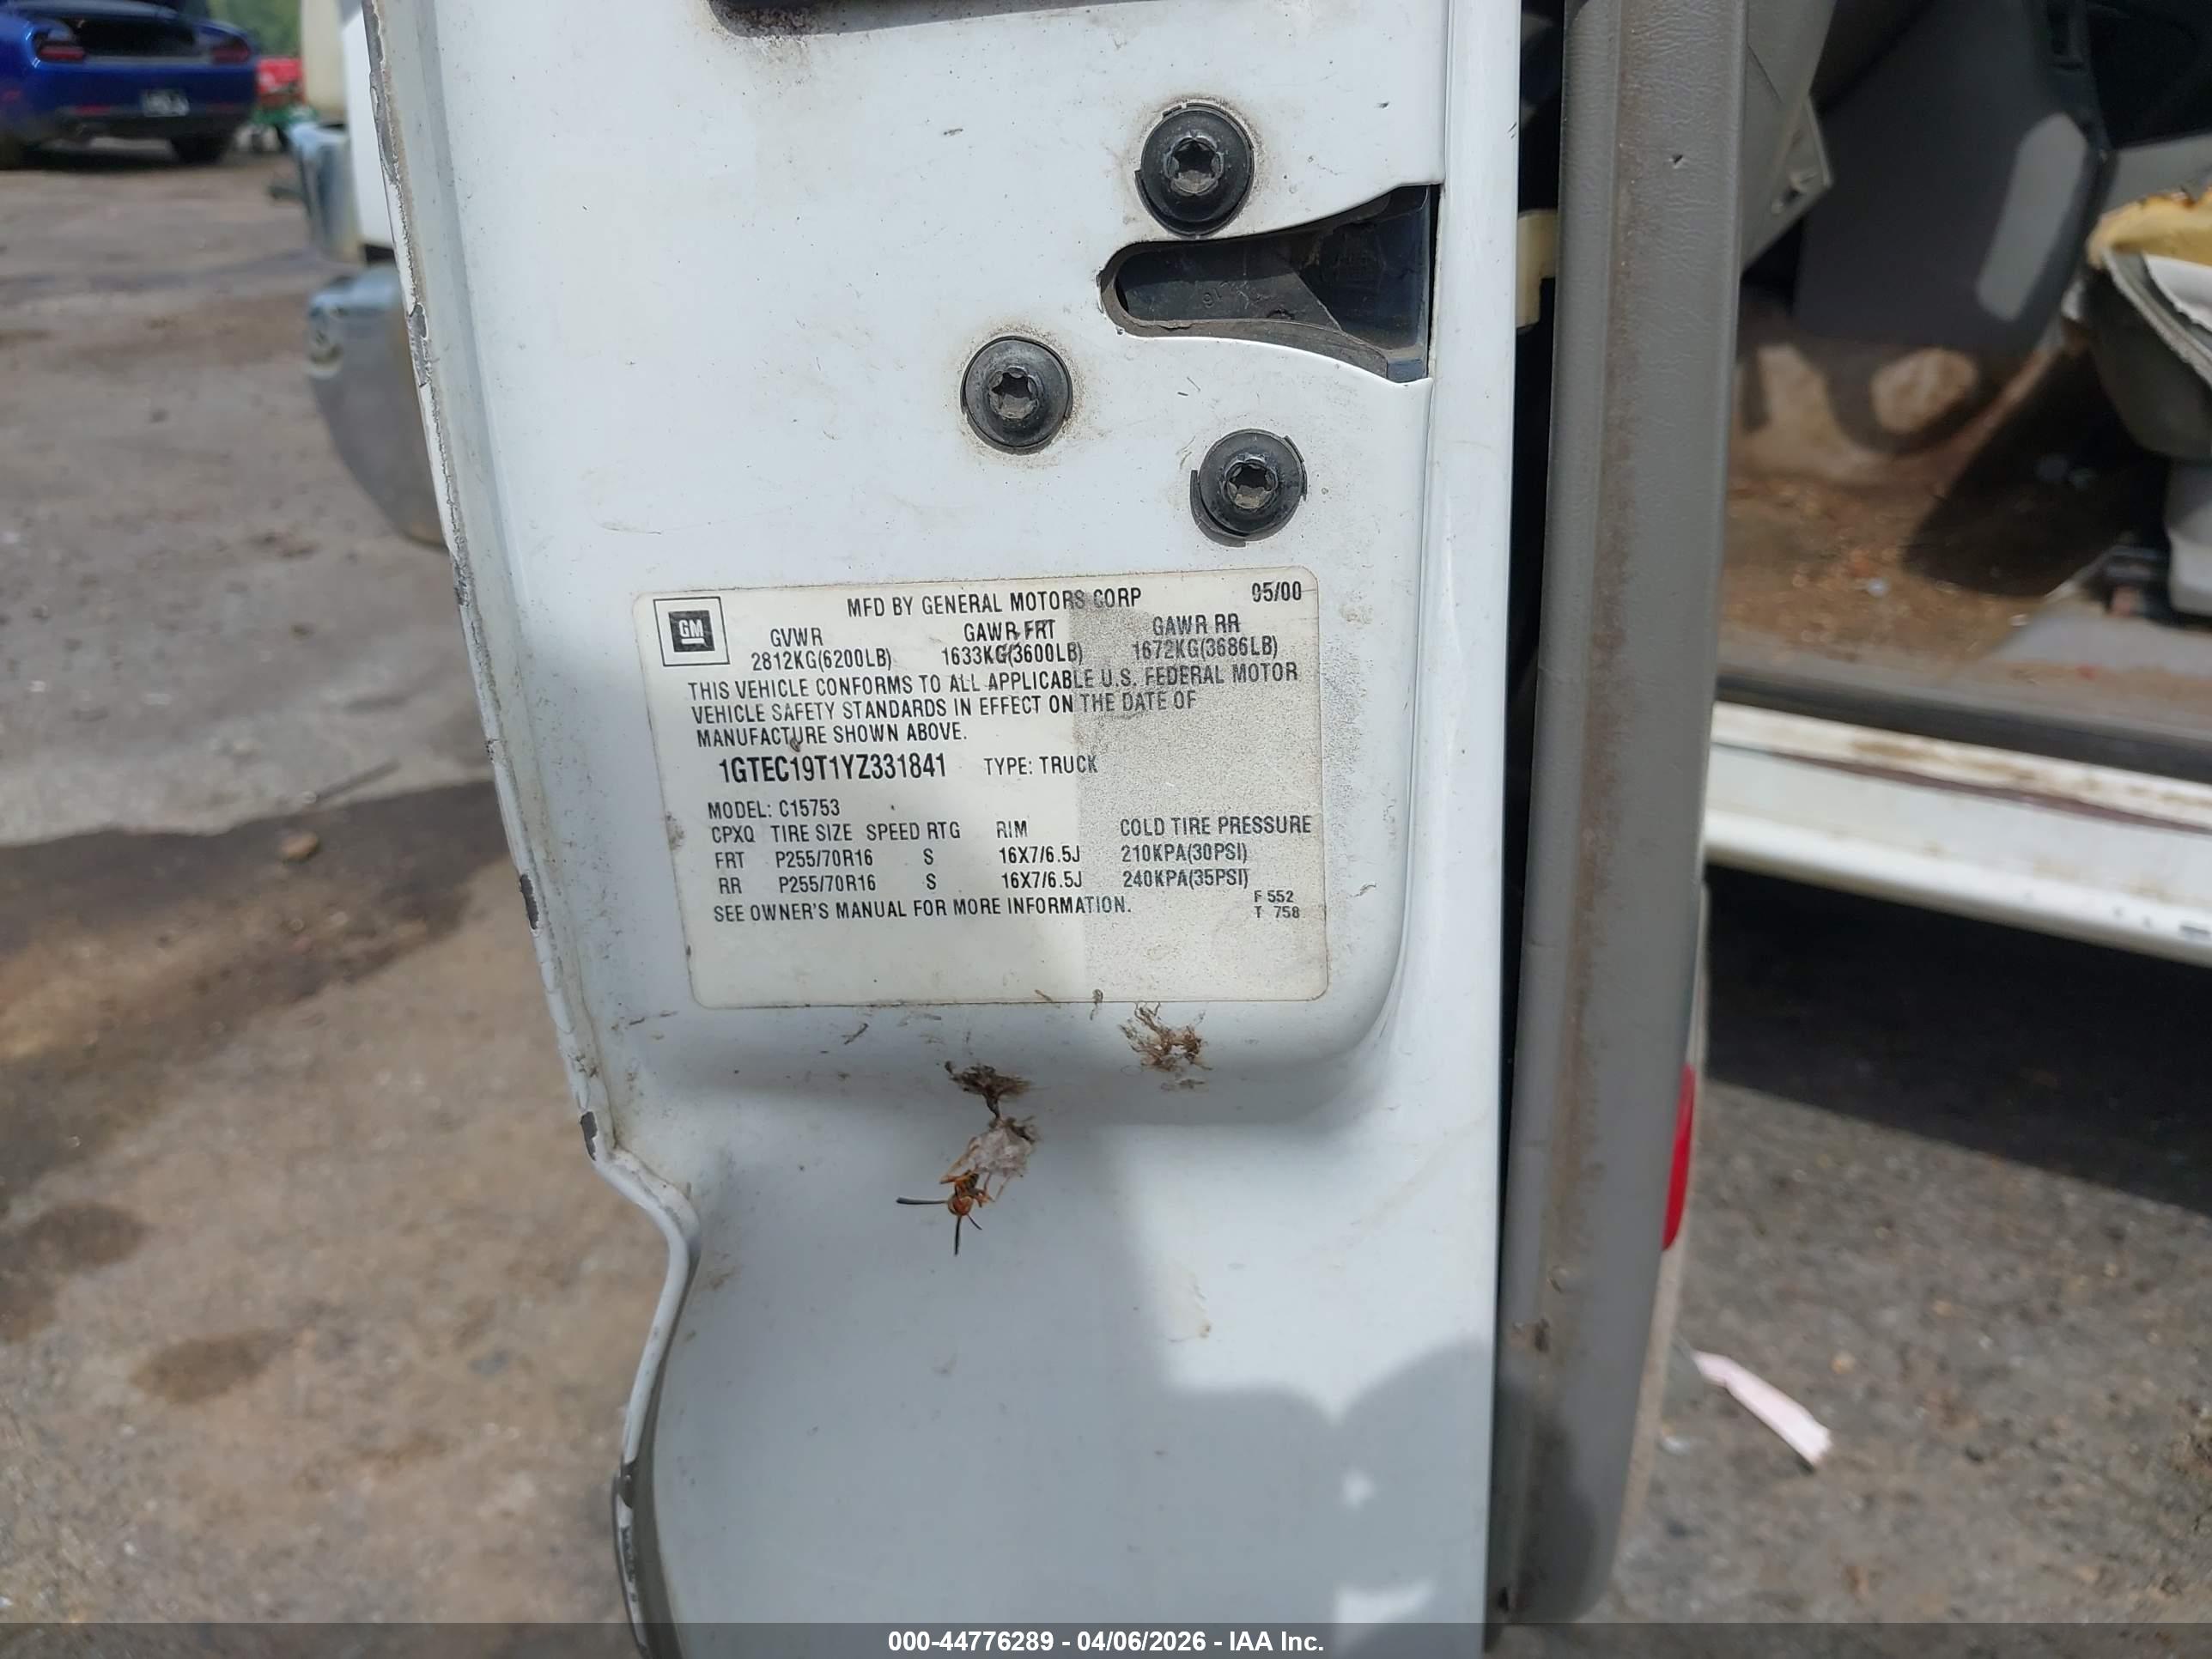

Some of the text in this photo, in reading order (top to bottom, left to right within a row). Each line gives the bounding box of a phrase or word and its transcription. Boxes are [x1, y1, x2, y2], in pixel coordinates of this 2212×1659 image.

[1252, 581, 1302, 602] 05/00
[848, 587, 1141, 617] MFD BY GENERAL MOTORS CORP
[678, 619, 704, 638] GM
[965, 619, 1055, 641] GAWR FRT
[1153, 613, 1241, 635] GAWR RR
[770, 628, 823, 647] GVWR
[941, 641, 1084, 667] 1633KG(3600LB)
[1133, 635, 1278, 661] 1672KG(3686LB)
[751, 647, 892, 672] 2812KG(6200LB)
[688, 661, 1298, 701] THIS VEHICLE CONFORMS TO ALL APPLICABLE U.S. FEDERAL MOTOR
[691, 690, 1196, 725] VEHICLE SAFETY STANDARDS IN EFFECT ON THE DATE OF
[697, 721, 967, 747] MANUFACTURE SHOWN ABOVE.
[720, 752, 946, 783] 1GTEC19T1YZ331841
[984, 754, 1099, 775] TYPE: TRUCK
[708, 799, 841, 819] MODEL: C15753
[712, 825, 755, 844] CPXQ
[771, 823, 853, 842] TIRE SIZE
[866, 821, 961, 841] SPEED RTG
[996, 820, 1028, 838] RIM
[1120, 815, 1312, 837] COLD TIRE PRESSURE
[715, 851, 744, 869] FRT
[775, 848, 873, 868] P255/70R16
[923, 848, 934, 865] S
[1000, 845, 1080, 864] 16X7/6.5J
[1121, 842, 1248, 864] 210KPA(30PSI)
[719, 877, 742, 894] RR
[779, 874, 876, 893] P255/70R16
[927, 873, 937, 890] S
[1002, 871, 1083, 889] 16X7/6.5J
[1122, 867, 1249, 890] 240KPA(35PSI)
[1254, 890, 1294, 903] F 552
[714, 895, 1132, 922] SEE OWNER'S MANUAL FOR MORE INFORMATION.
[1254, 905, 1299, 919] T 758
